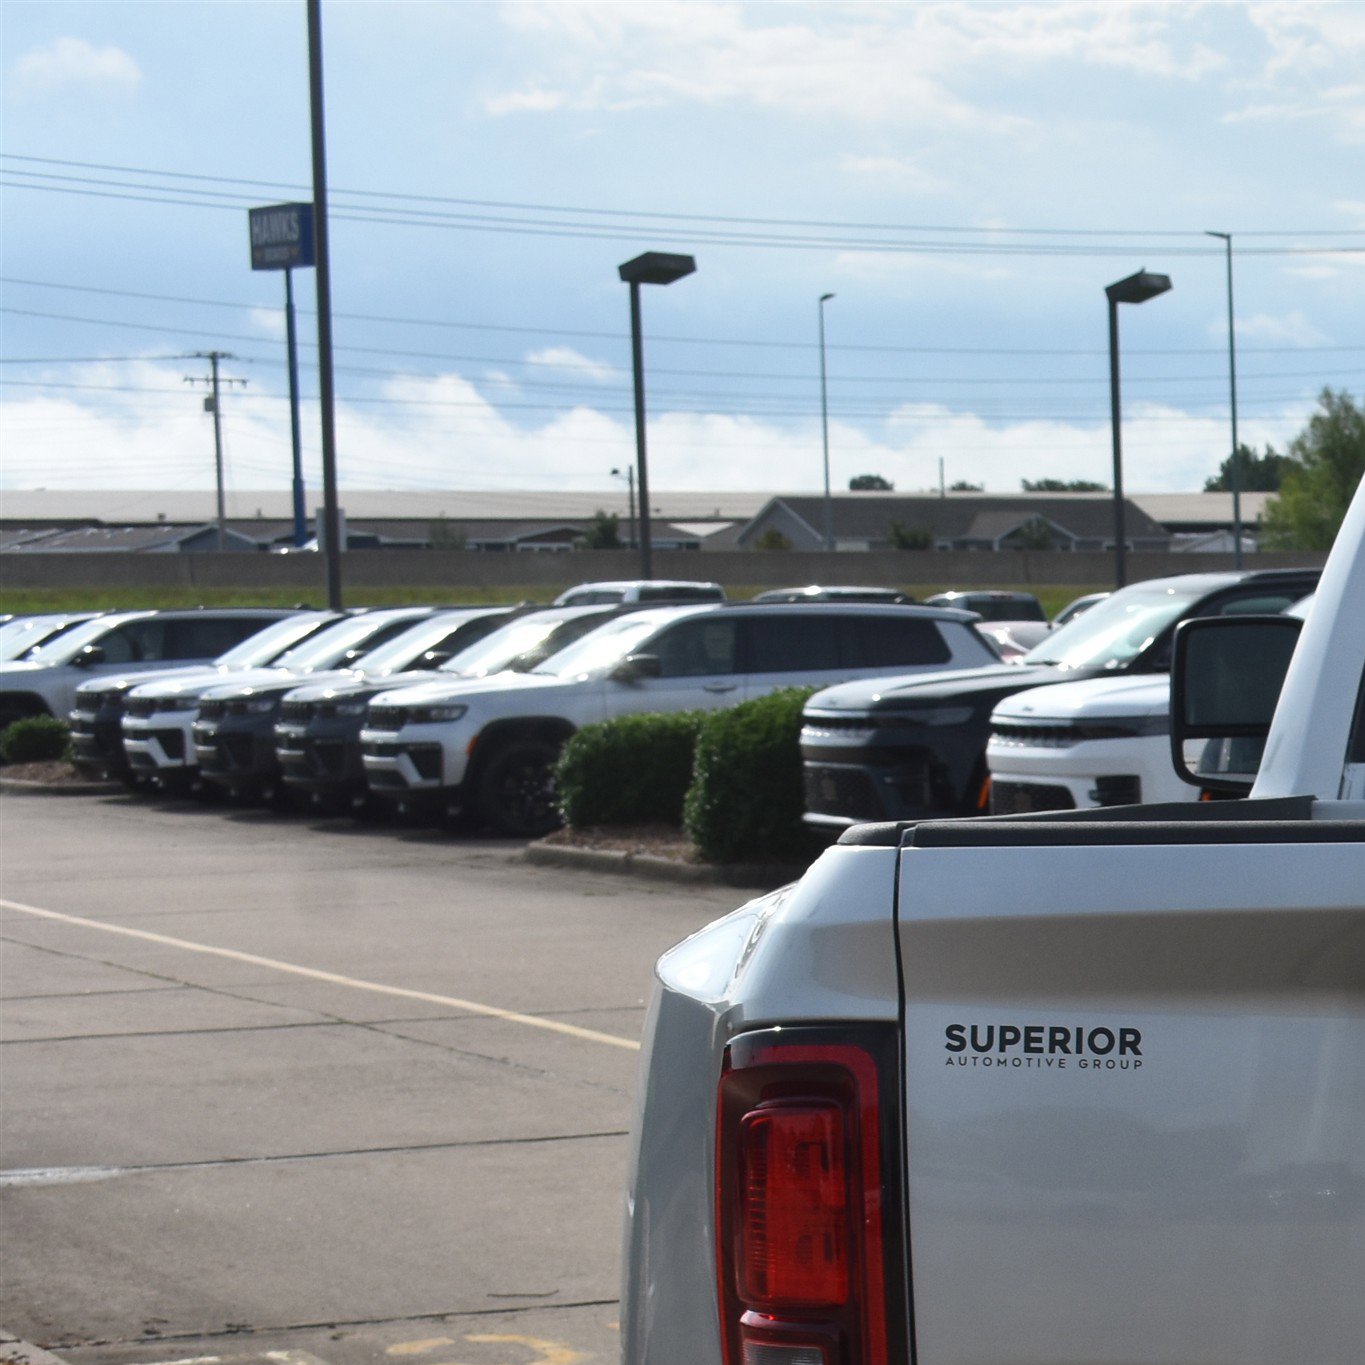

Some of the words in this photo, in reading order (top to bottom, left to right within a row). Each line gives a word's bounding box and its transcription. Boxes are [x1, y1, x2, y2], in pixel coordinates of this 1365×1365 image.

[944, 1023, 1143, 1056] SUPERIOR
[945, 1056, 1067, 1069] AUTOMOTIVE
[1078, 1058, 1143, 1070] GROUP
